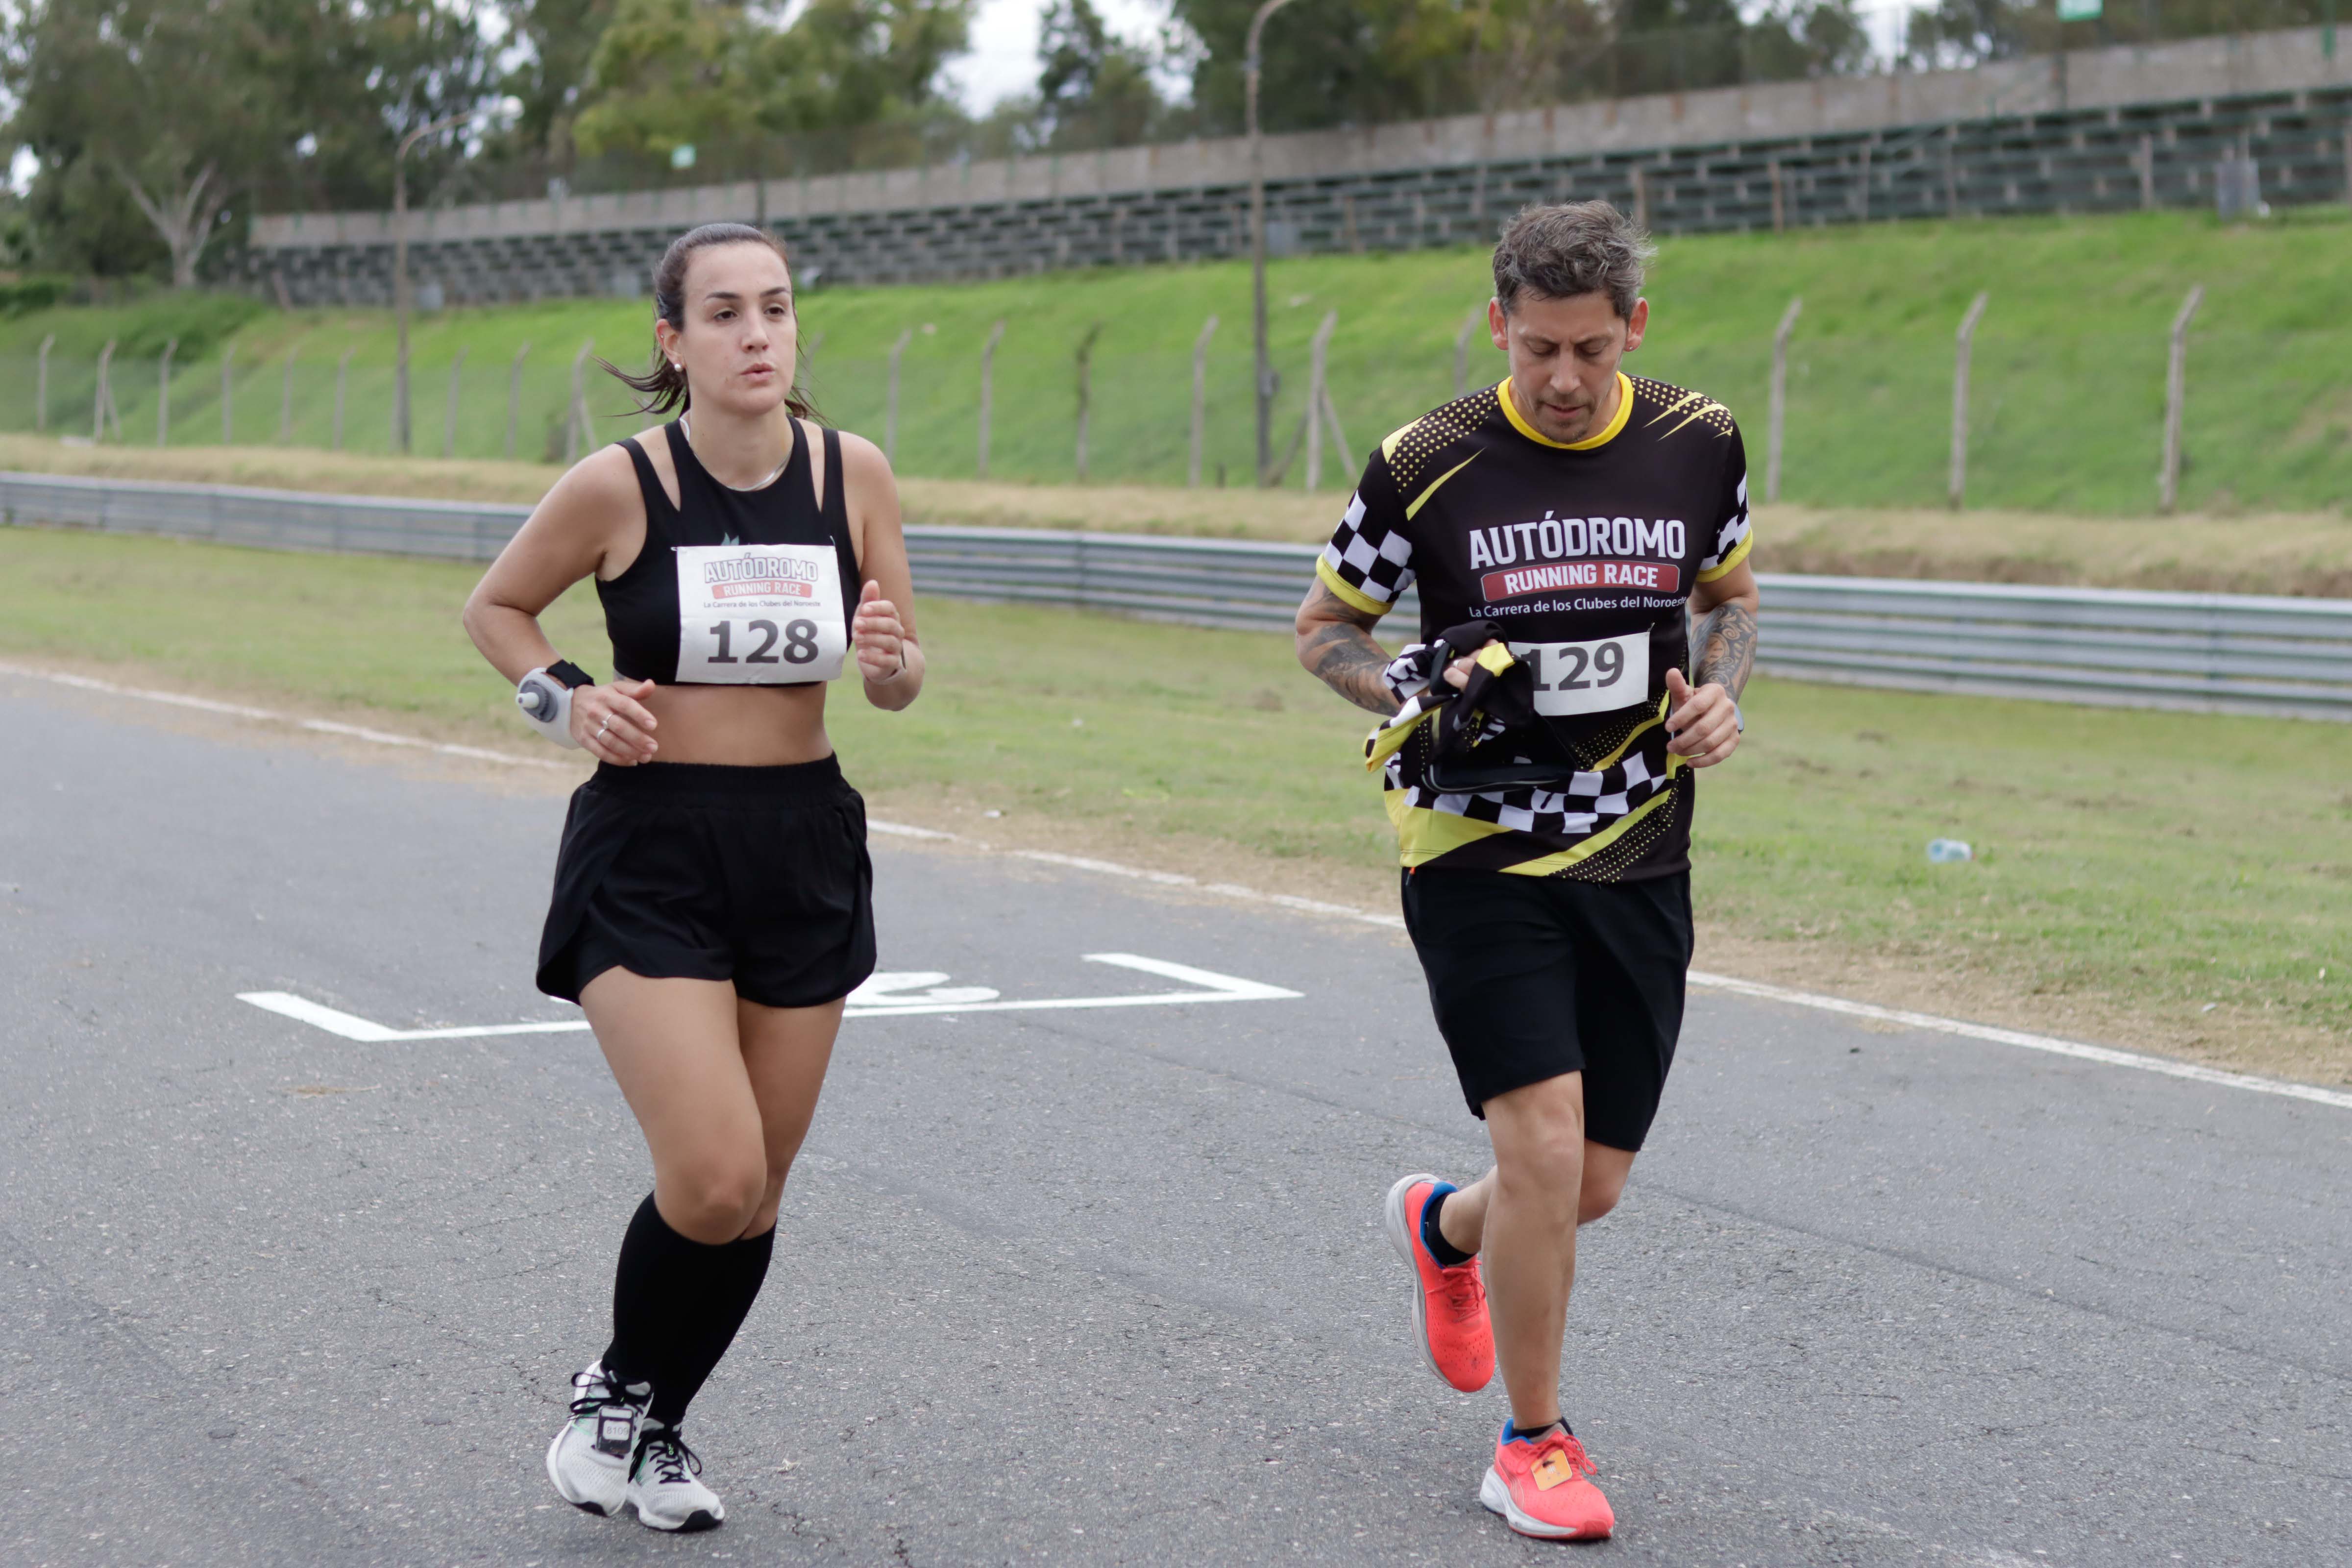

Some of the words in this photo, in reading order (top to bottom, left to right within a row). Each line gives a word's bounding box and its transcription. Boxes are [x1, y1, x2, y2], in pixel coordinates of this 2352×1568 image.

[1469, 510, 1686, 570] AUTÓDROMO
[704, 552, 818, 583] AUTÓDROMO
[1504, 564, 1597, 594] RUNNING
[1604, 564, 1659, 588] RACE
[723, 582, 771, 596] RUNNING
[774, 582, 802, 595] RACE
[1469, 606, 1482, 617] La
[1484, 604, 1531, 617] Carrera
[1533, 600, 1550, 612] de
[1553, 599, 1571, 611] los
[1574, 597, 1617, 610] Clubes
[1620, 596, 1640, 608] del
[1643, 596, 1687, 608] Noroeste
[708, 619, 818, 664] 128
[1520, 641, 1624, 691] 129
